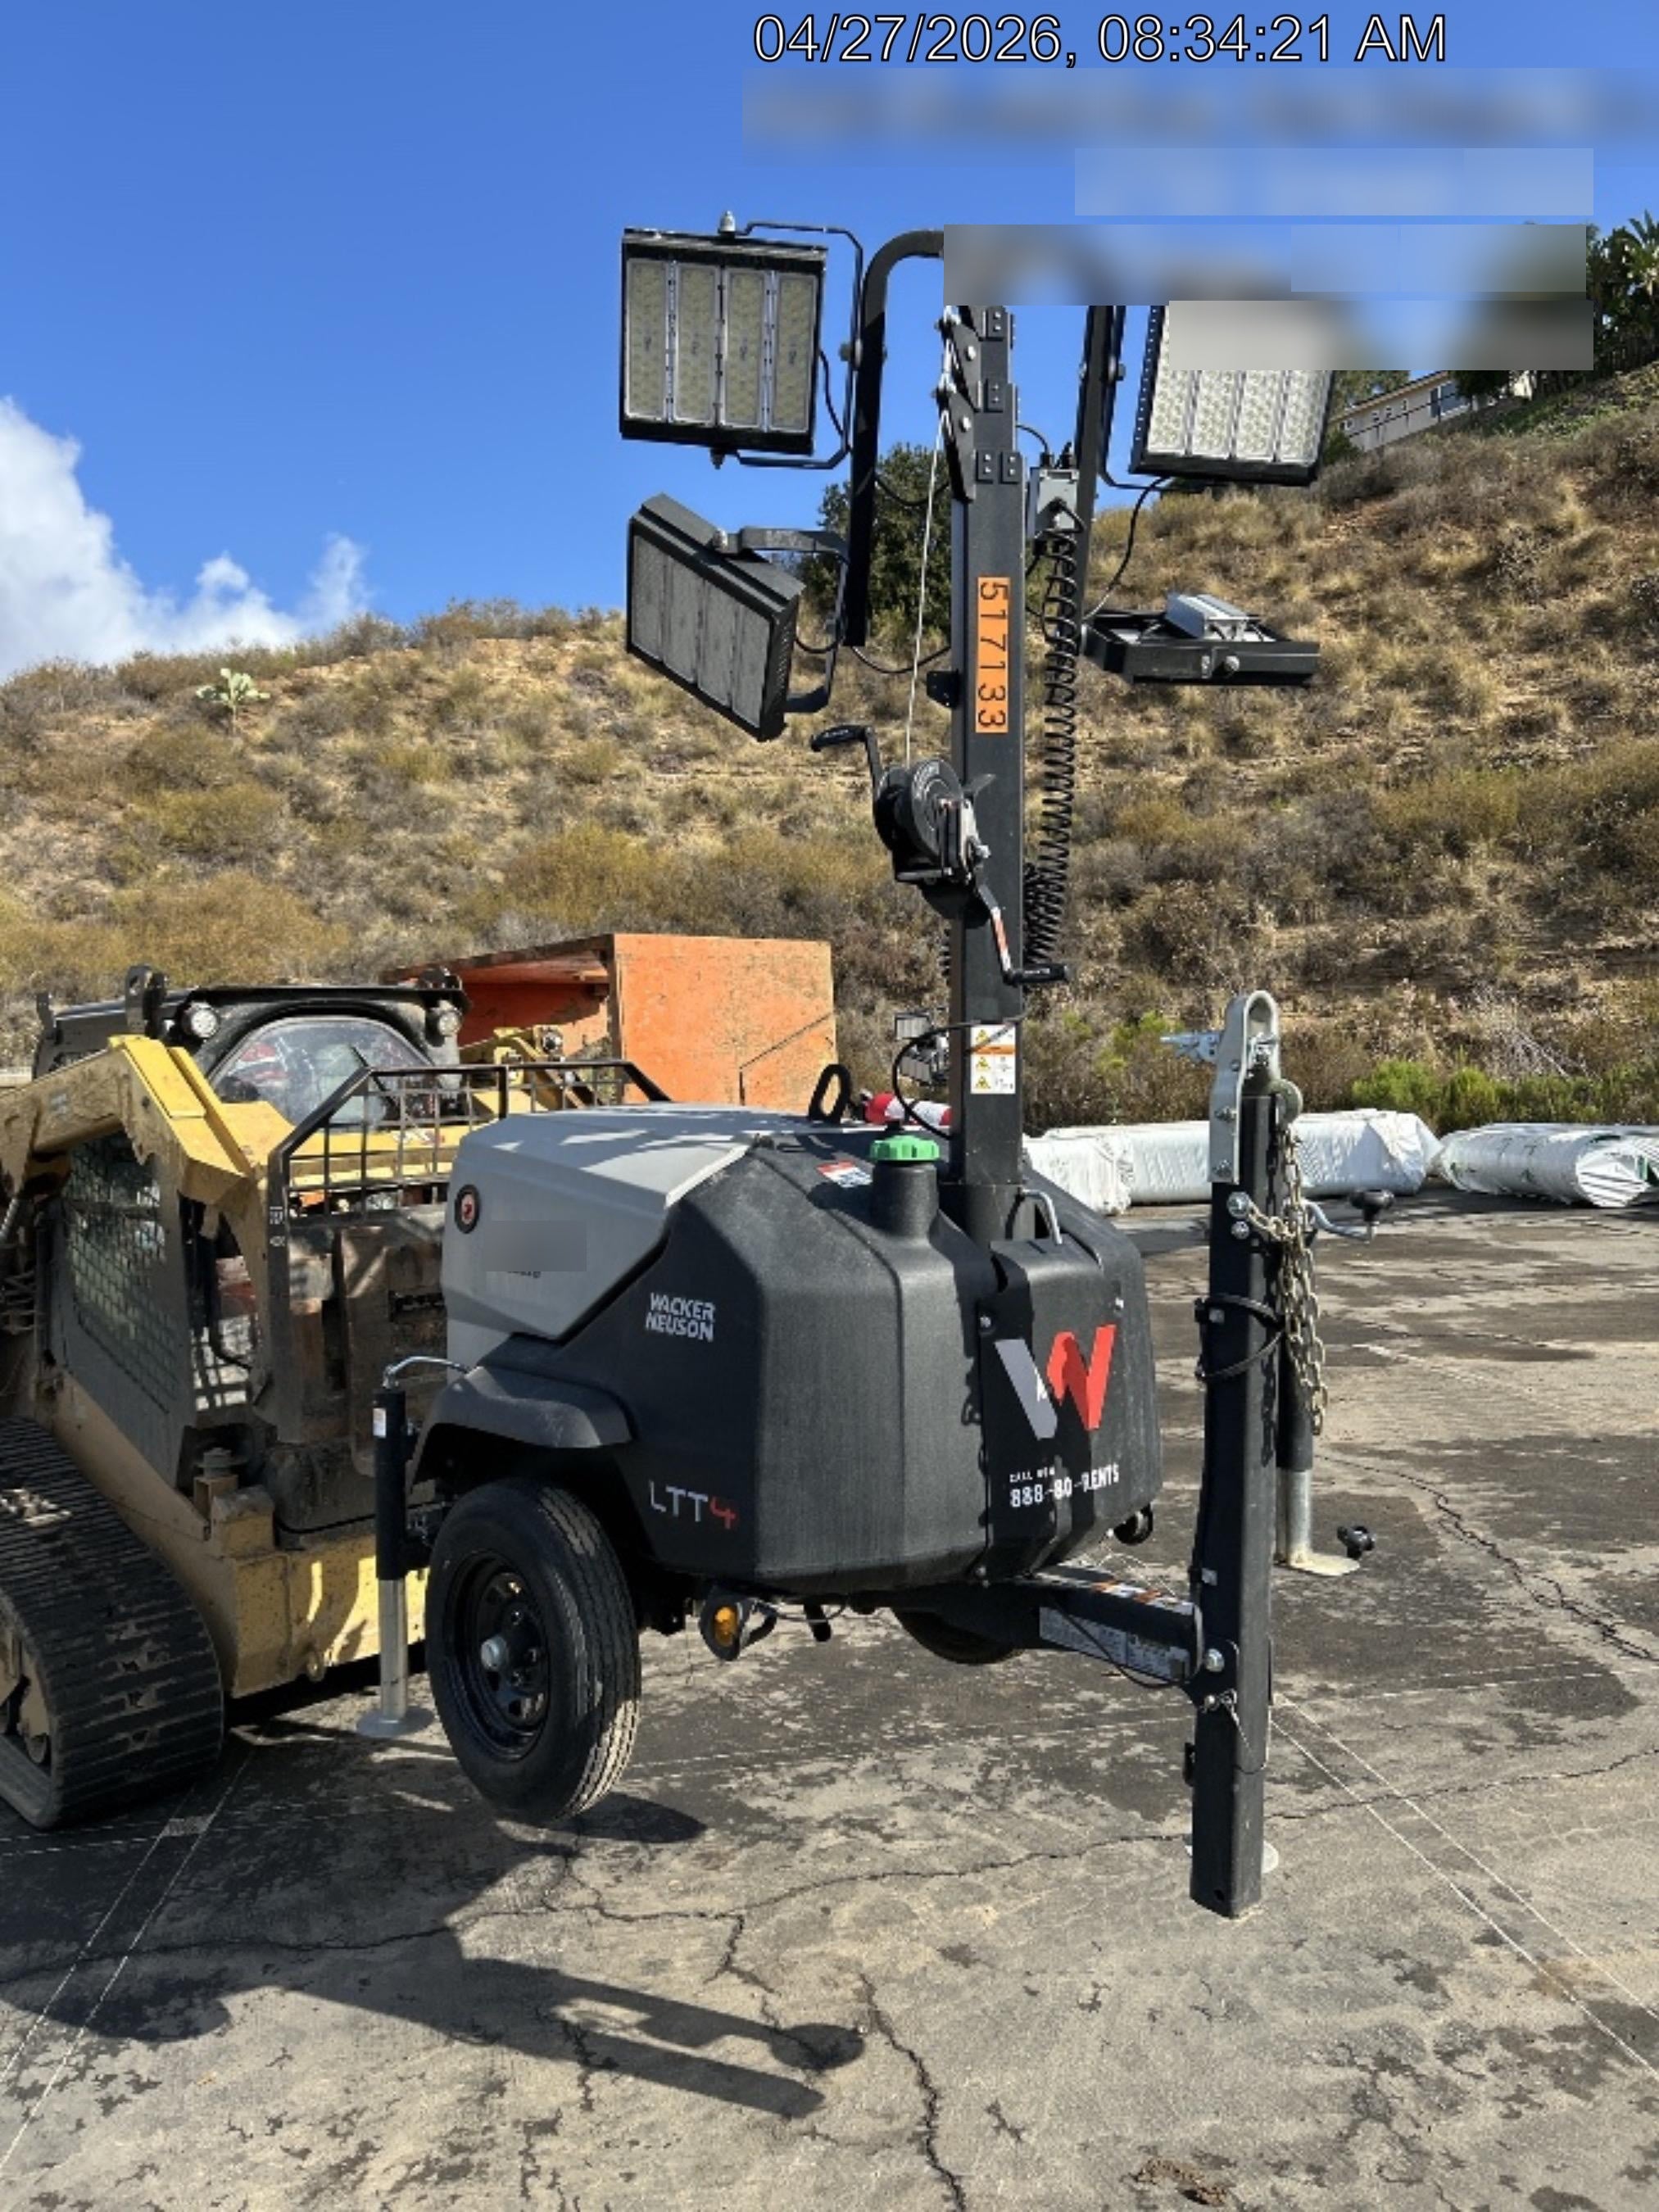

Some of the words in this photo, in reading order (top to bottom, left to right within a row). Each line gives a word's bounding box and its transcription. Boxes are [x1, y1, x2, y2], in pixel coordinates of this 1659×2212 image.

[978, 581, 1009, 728] 517133
[650, 1292, 715, 1321] WACKER
[645, 1312, 714, 1342] NEUSON
[648, 1479, 737, 1530] LTT4
